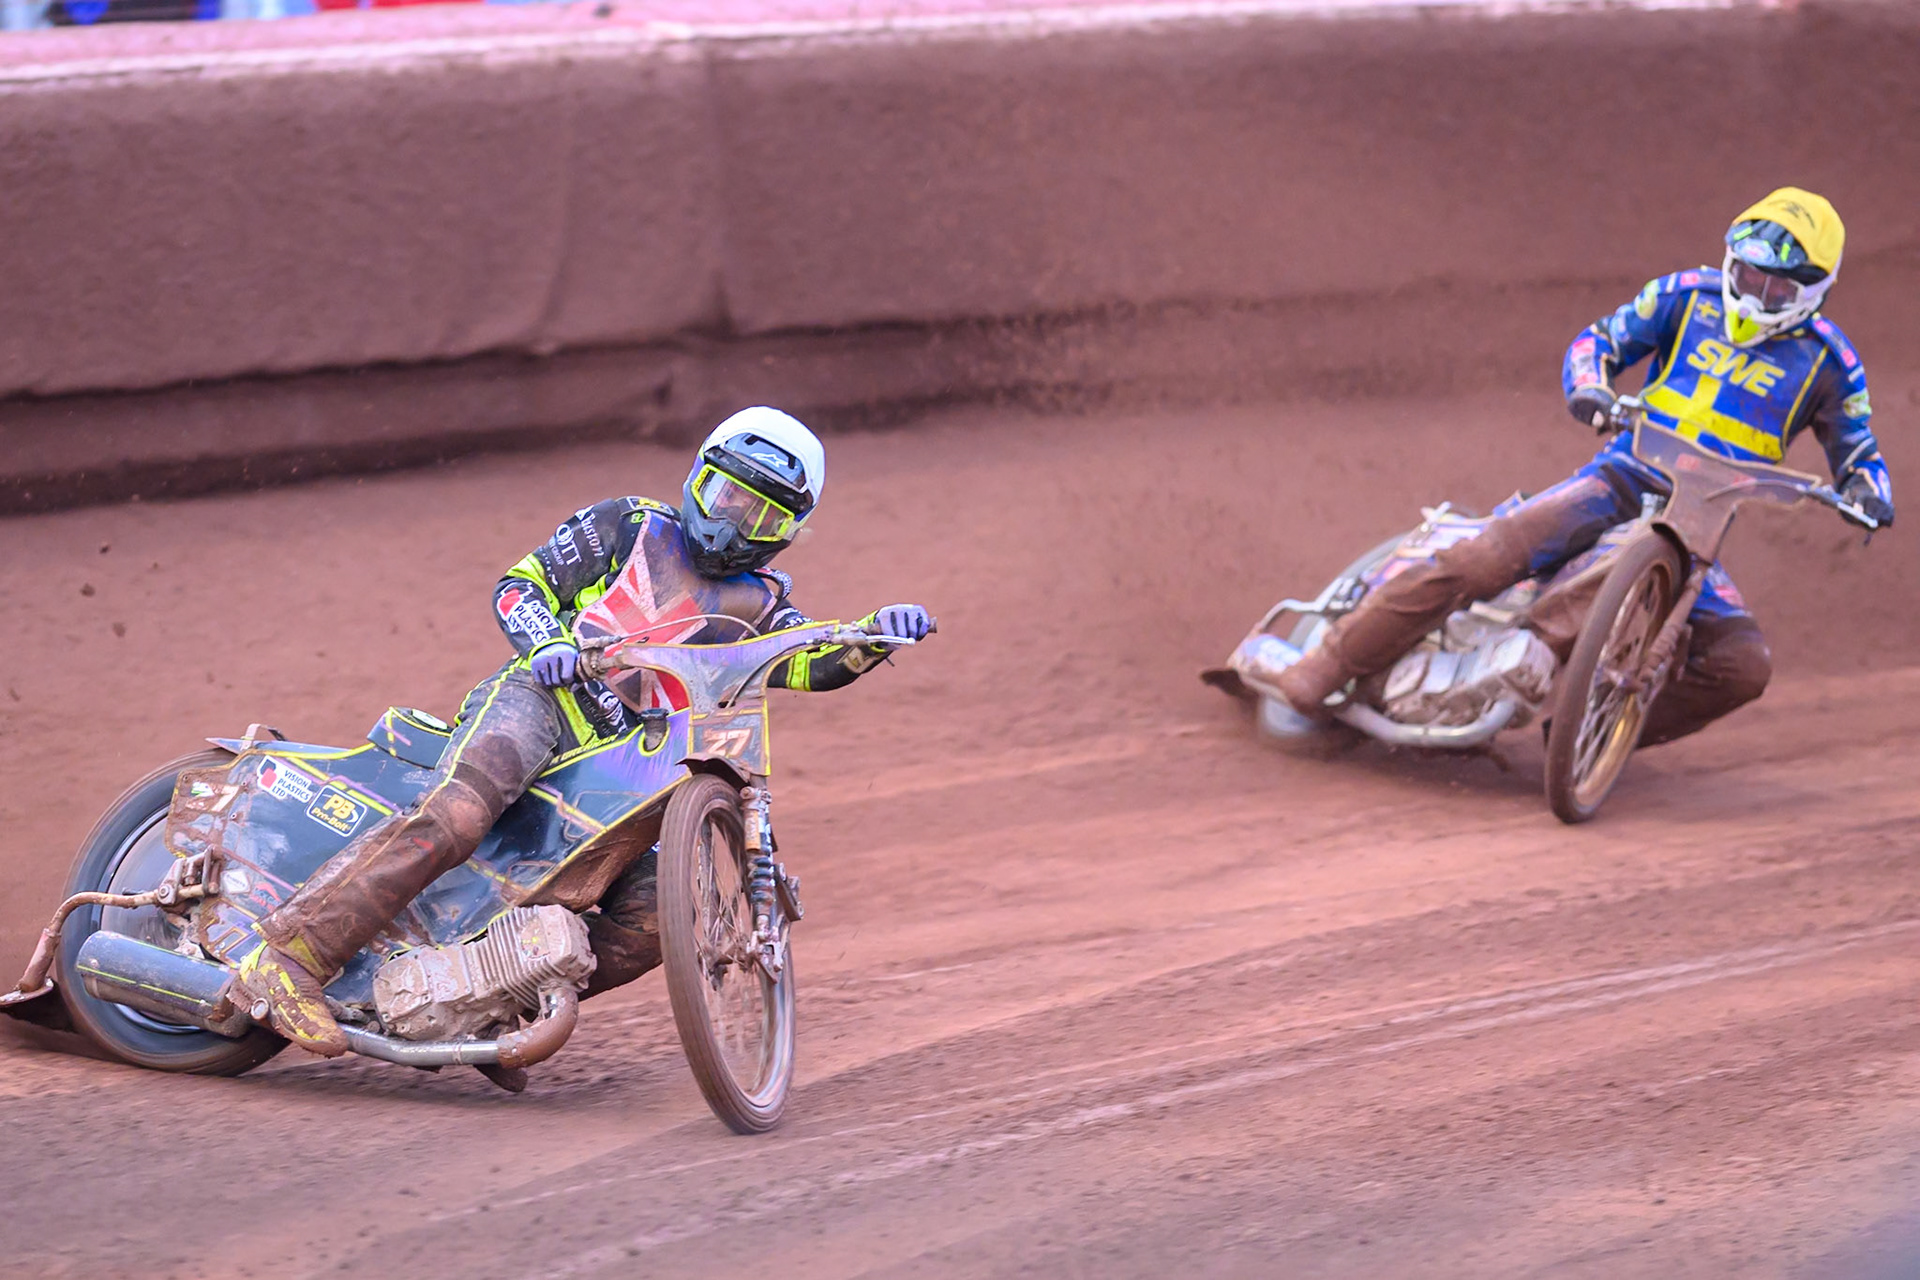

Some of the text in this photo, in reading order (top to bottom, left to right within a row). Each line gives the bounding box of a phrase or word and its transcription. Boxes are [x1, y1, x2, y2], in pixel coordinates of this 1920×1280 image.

[1687, 338, 1786, 397] SWE
[702, 726, 751, 758] 27
[271, 785, 286, 798] LTD
[277, 778, 310, 801] PLASTICS
[284, 769, 308, 789] VISION
[322, 793, 357, 820] PB
